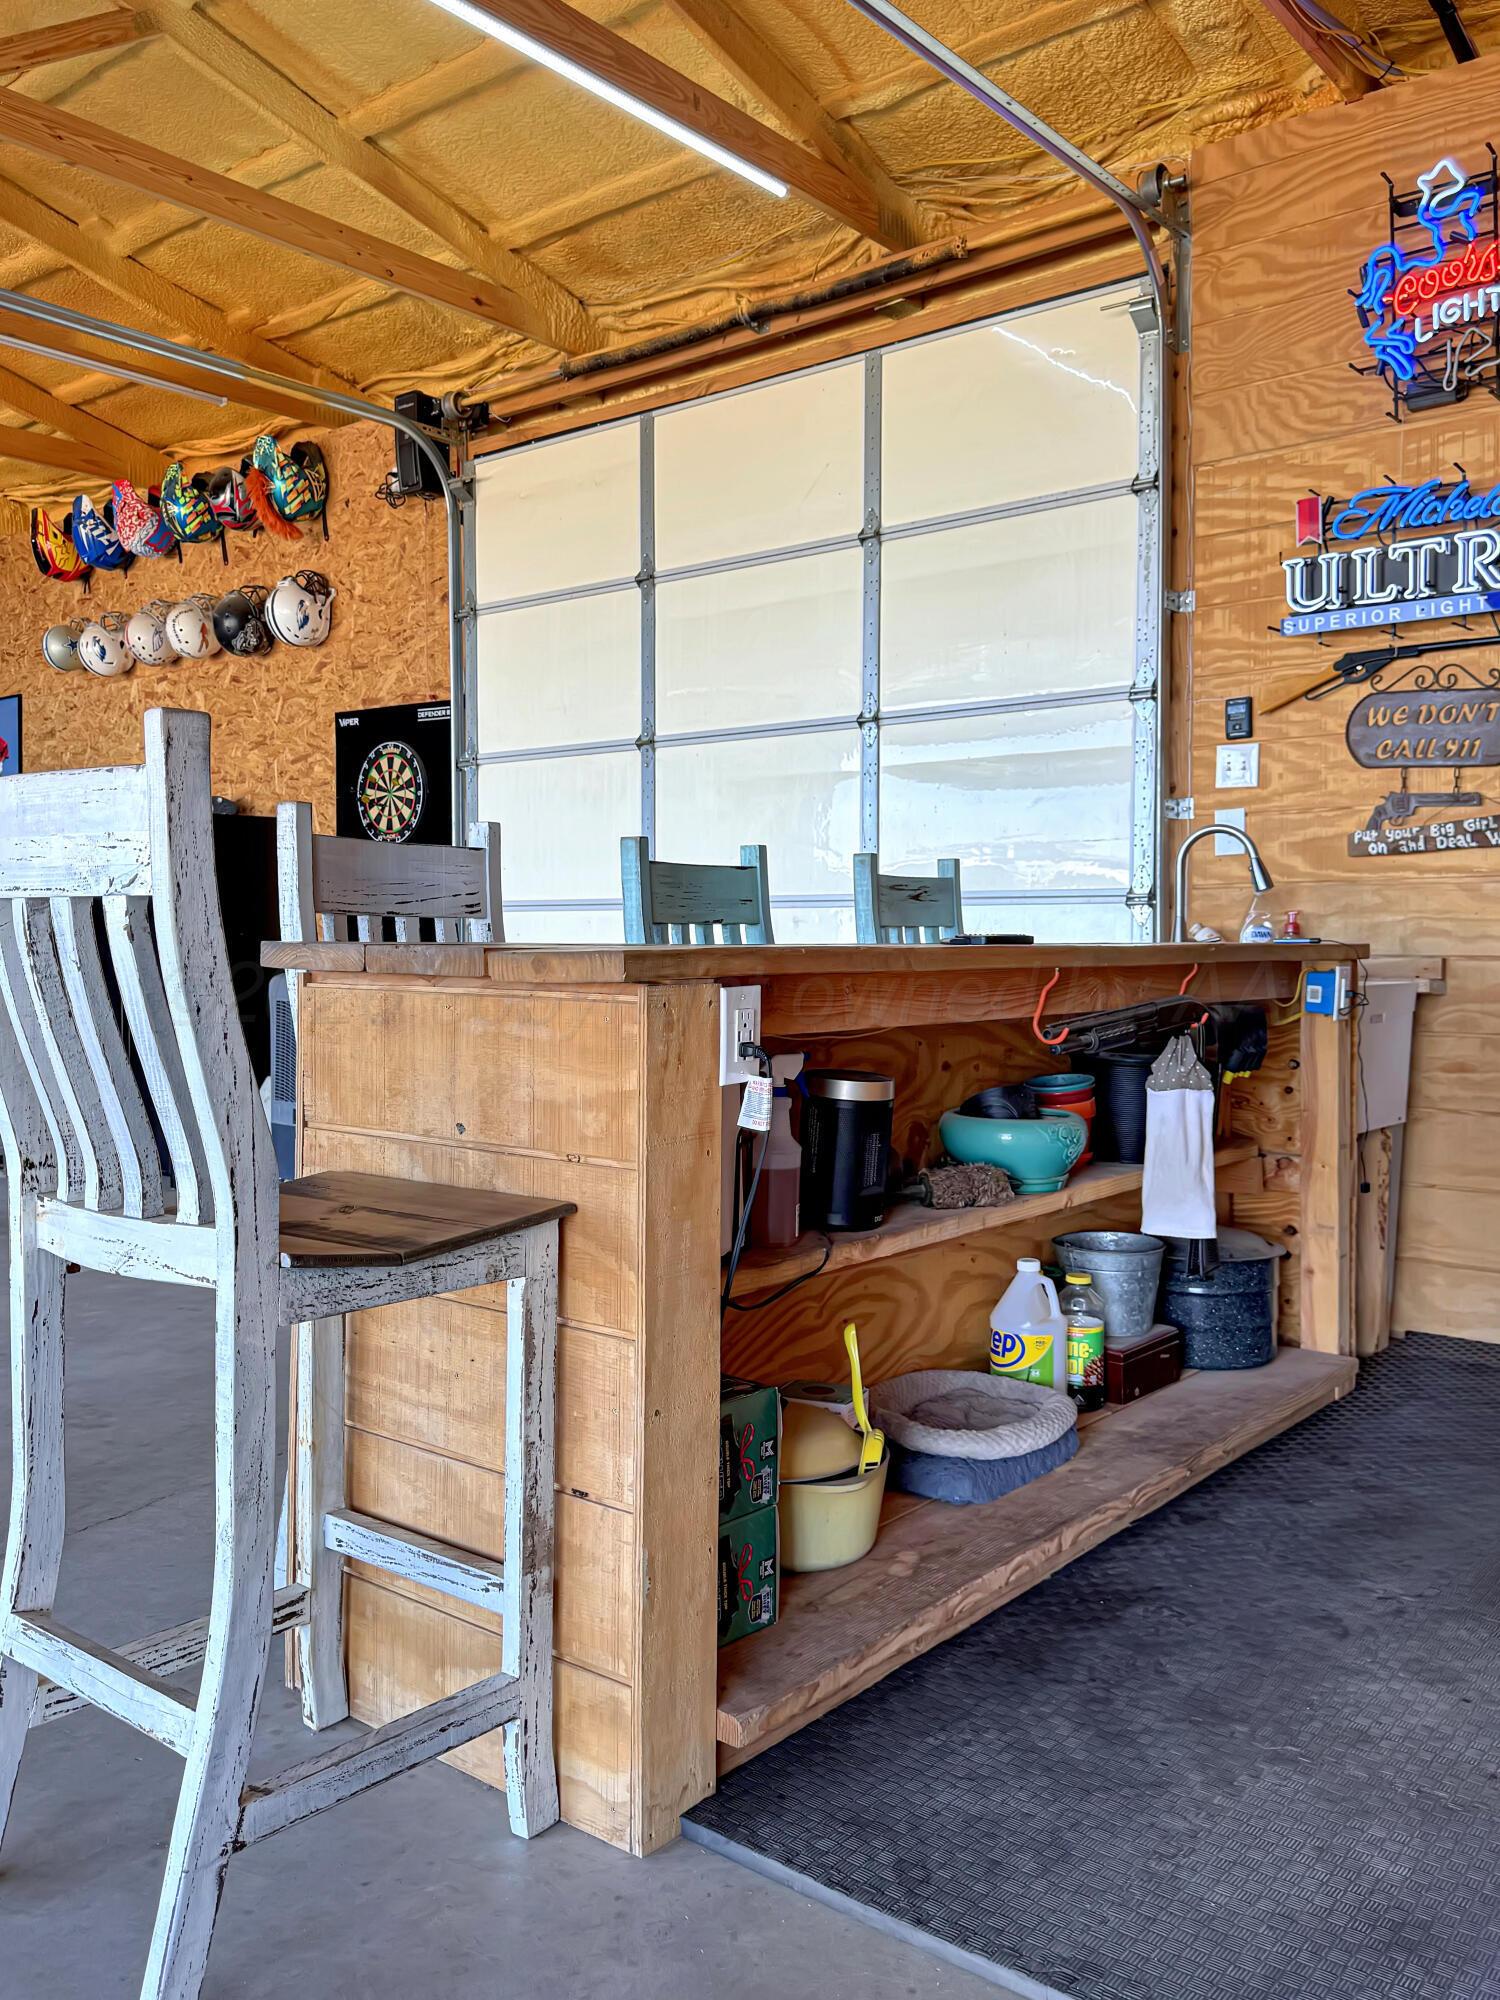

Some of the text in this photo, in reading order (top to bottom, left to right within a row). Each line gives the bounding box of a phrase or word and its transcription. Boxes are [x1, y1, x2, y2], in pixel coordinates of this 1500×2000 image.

[1393, 242, 1499, 316] Coors
[1414, 285, 1500, 343] LIGHT
[1282, 528, 1500, 612] ULTR
[1283, 596, 1489, 634] SUPERIOR LIGHT
[1367, 703, 1500, 728] WE DON'T
[1376, 738, 1481, 760] CALL 911
[1368, 842, 1388, 855] on
[1399, 835, 1426, 852] and
[1429, 823, 1456, 837] Big
